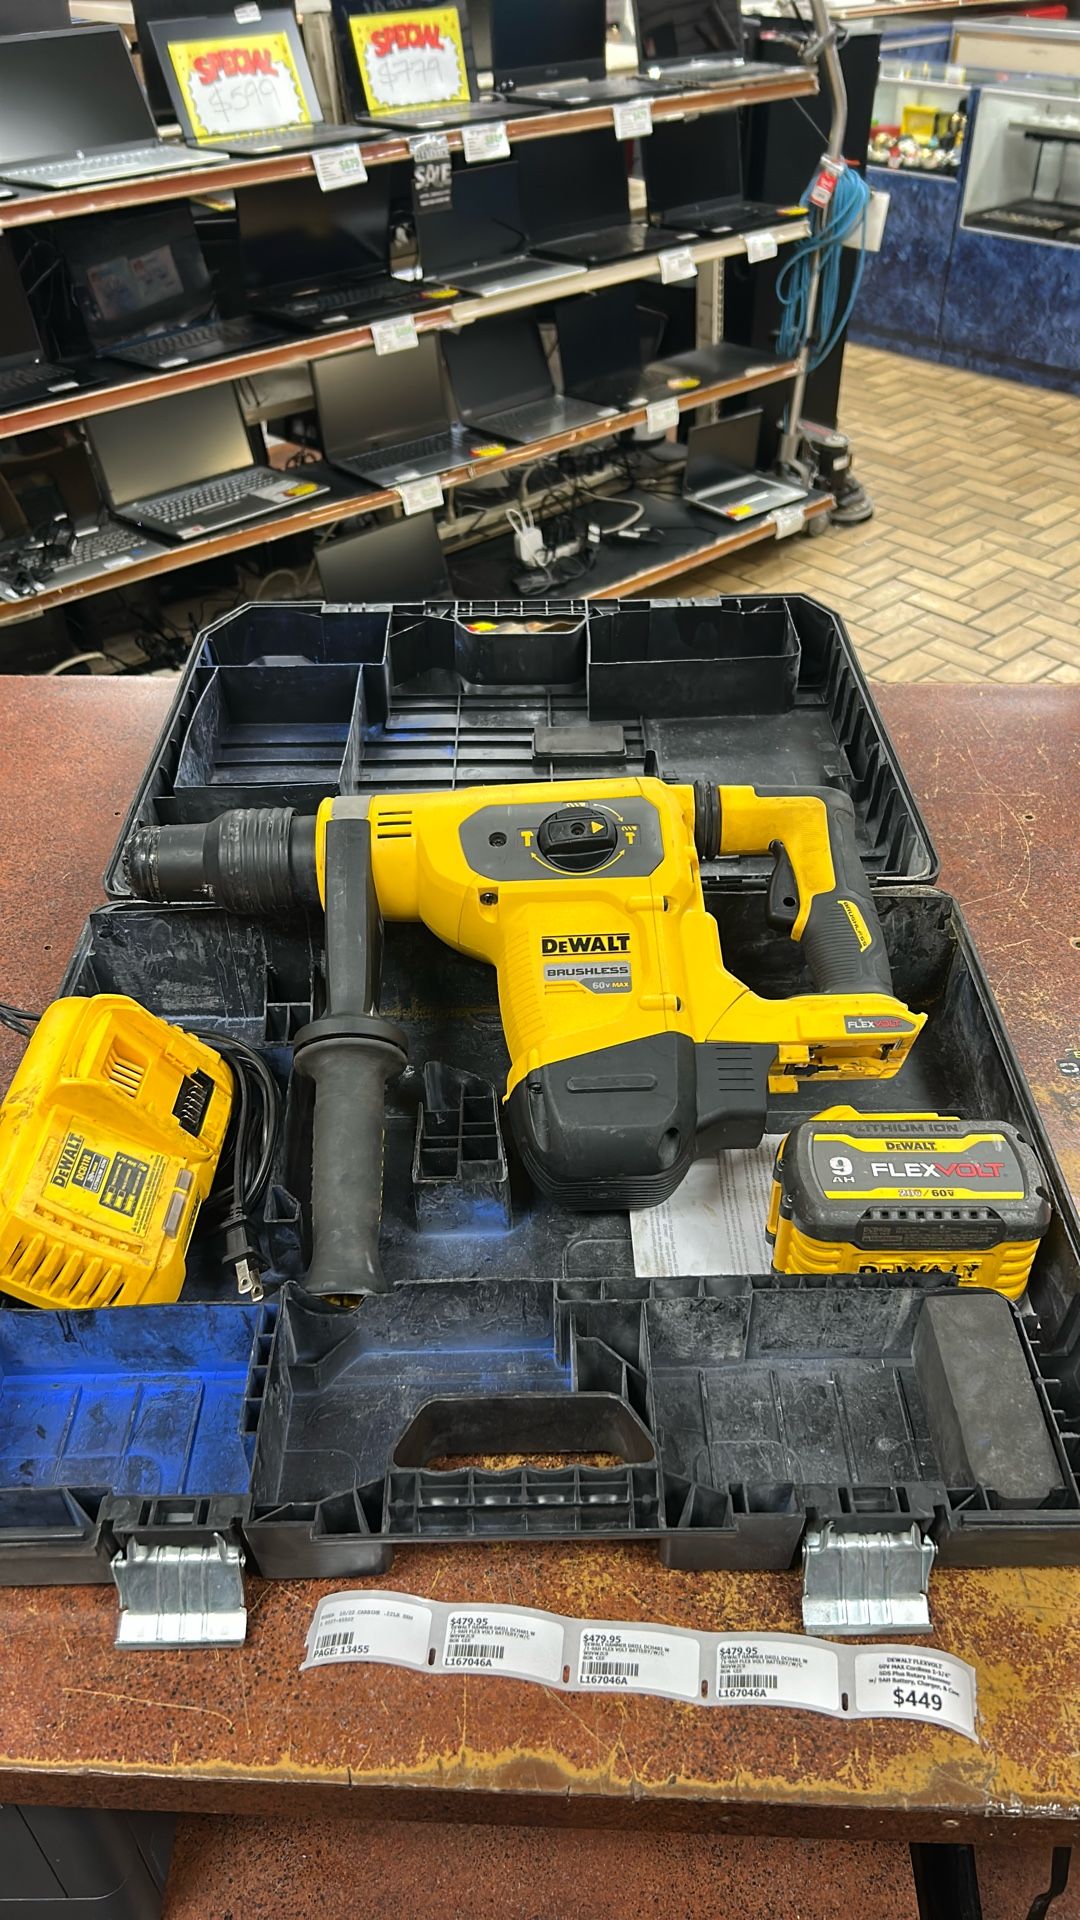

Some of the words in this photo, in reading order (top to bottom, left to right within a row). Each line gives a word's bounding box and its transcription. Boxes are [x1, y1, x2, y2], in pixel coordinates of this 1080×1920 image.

[370, 22, 445, 58] SPECIAL
[193, 47, 279, 86] SPECIAL
[547, 966, 629, 978] BRUSHLESS
[847, 1019, 903, 1029] FLEXVOLT
[856, 1123, 925, 1132] LITHIUM
[929, 1123, 959, 1132] ION
[829, 1156, 853, 1176] 9
[870, 1162, 1006, 1178] FLEXVOLT
[450, 1617, 489, 1626] $479.95
[583, 1634, 622, 1643] $479.95
[313, 1647, 338, 1658] PAGE:
[340, 1645, 370, 1655] 13455
[719, 1647, 758, 1656] $479.95
[444, 1657, 493, 1667] L167046A
[579, 1675, 628, 1685] L167046A
[718, 1689, 767, 1698] L167046A
[893, 1686, 943, 1711] $449
